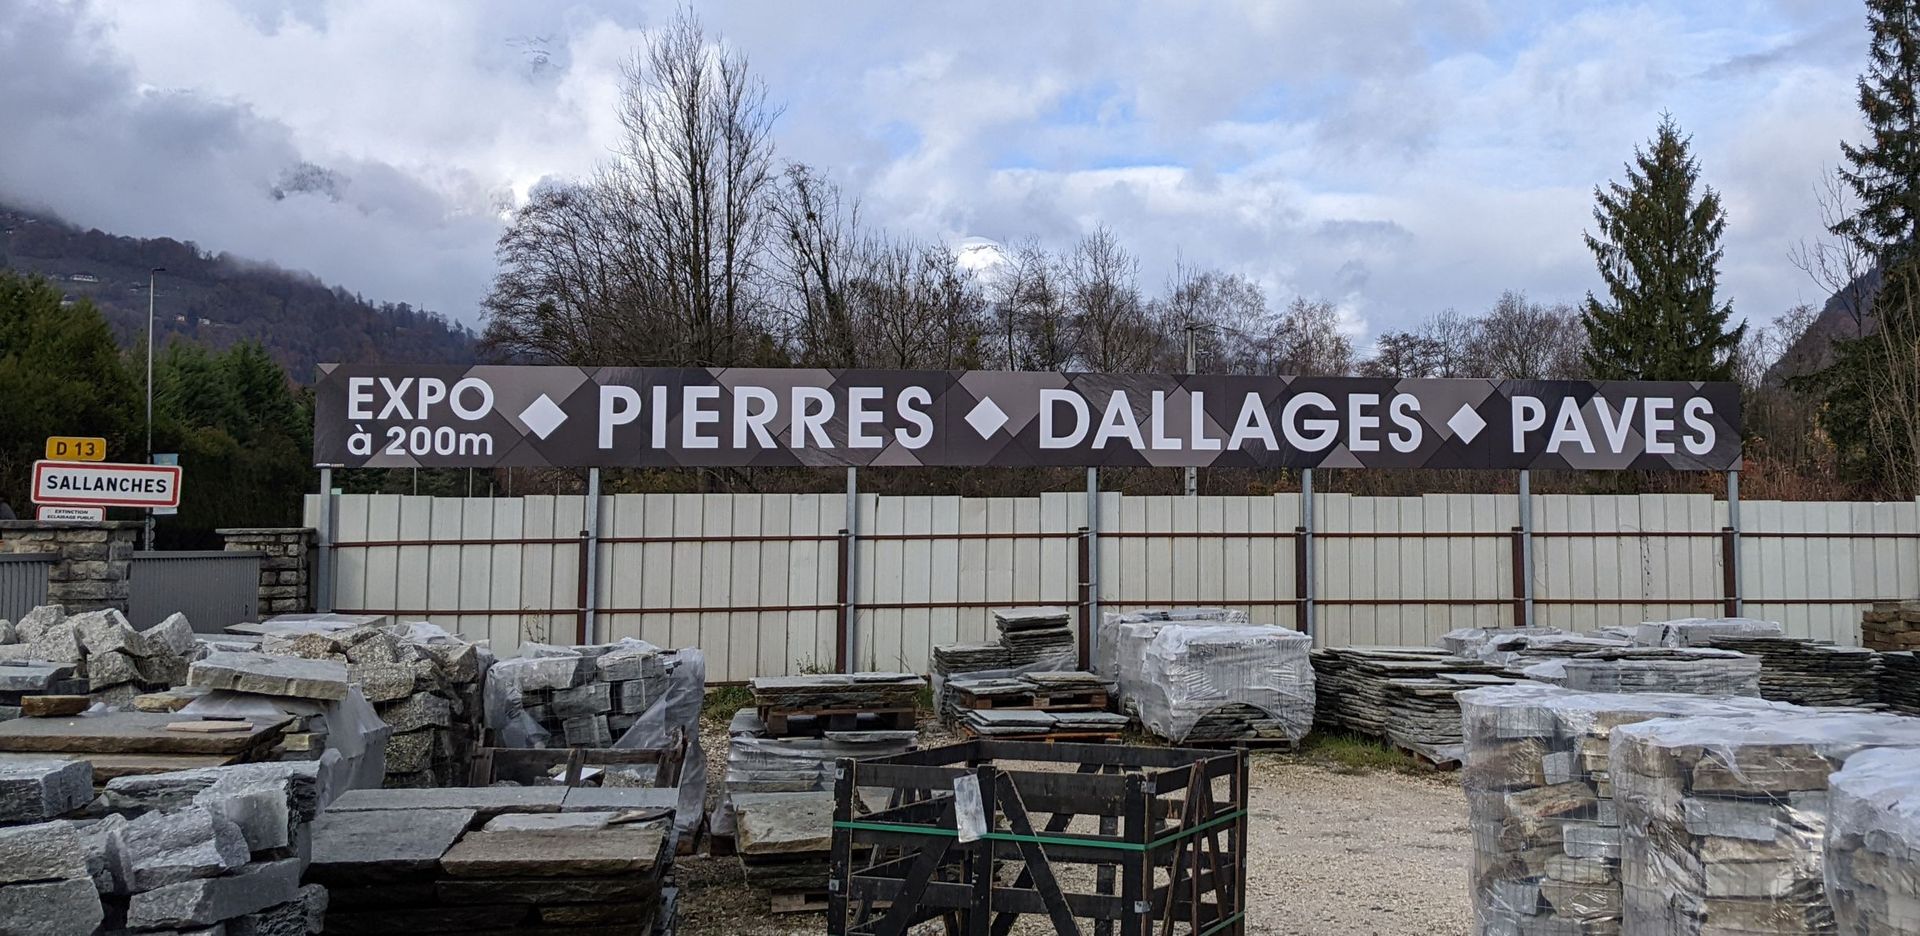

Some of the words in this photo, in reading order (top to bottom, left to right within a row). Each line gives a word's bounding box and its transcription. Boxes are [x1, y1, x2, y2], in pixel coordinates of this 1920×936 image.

[347, 377, 494, 421] EXPO
[598, 385, 934, 450] PIERRES
[1039, 388, 1423, 454] DALLAGES
[1511, 396, 1716, 455] PAVES
[56, 442, 67, 456] D
[75, 442, 95, 456] 13
[347, 426, 372, 456] à
[385, 426, 493, 456] 200m
[47, 475, 167, 493] SALLANCHES
